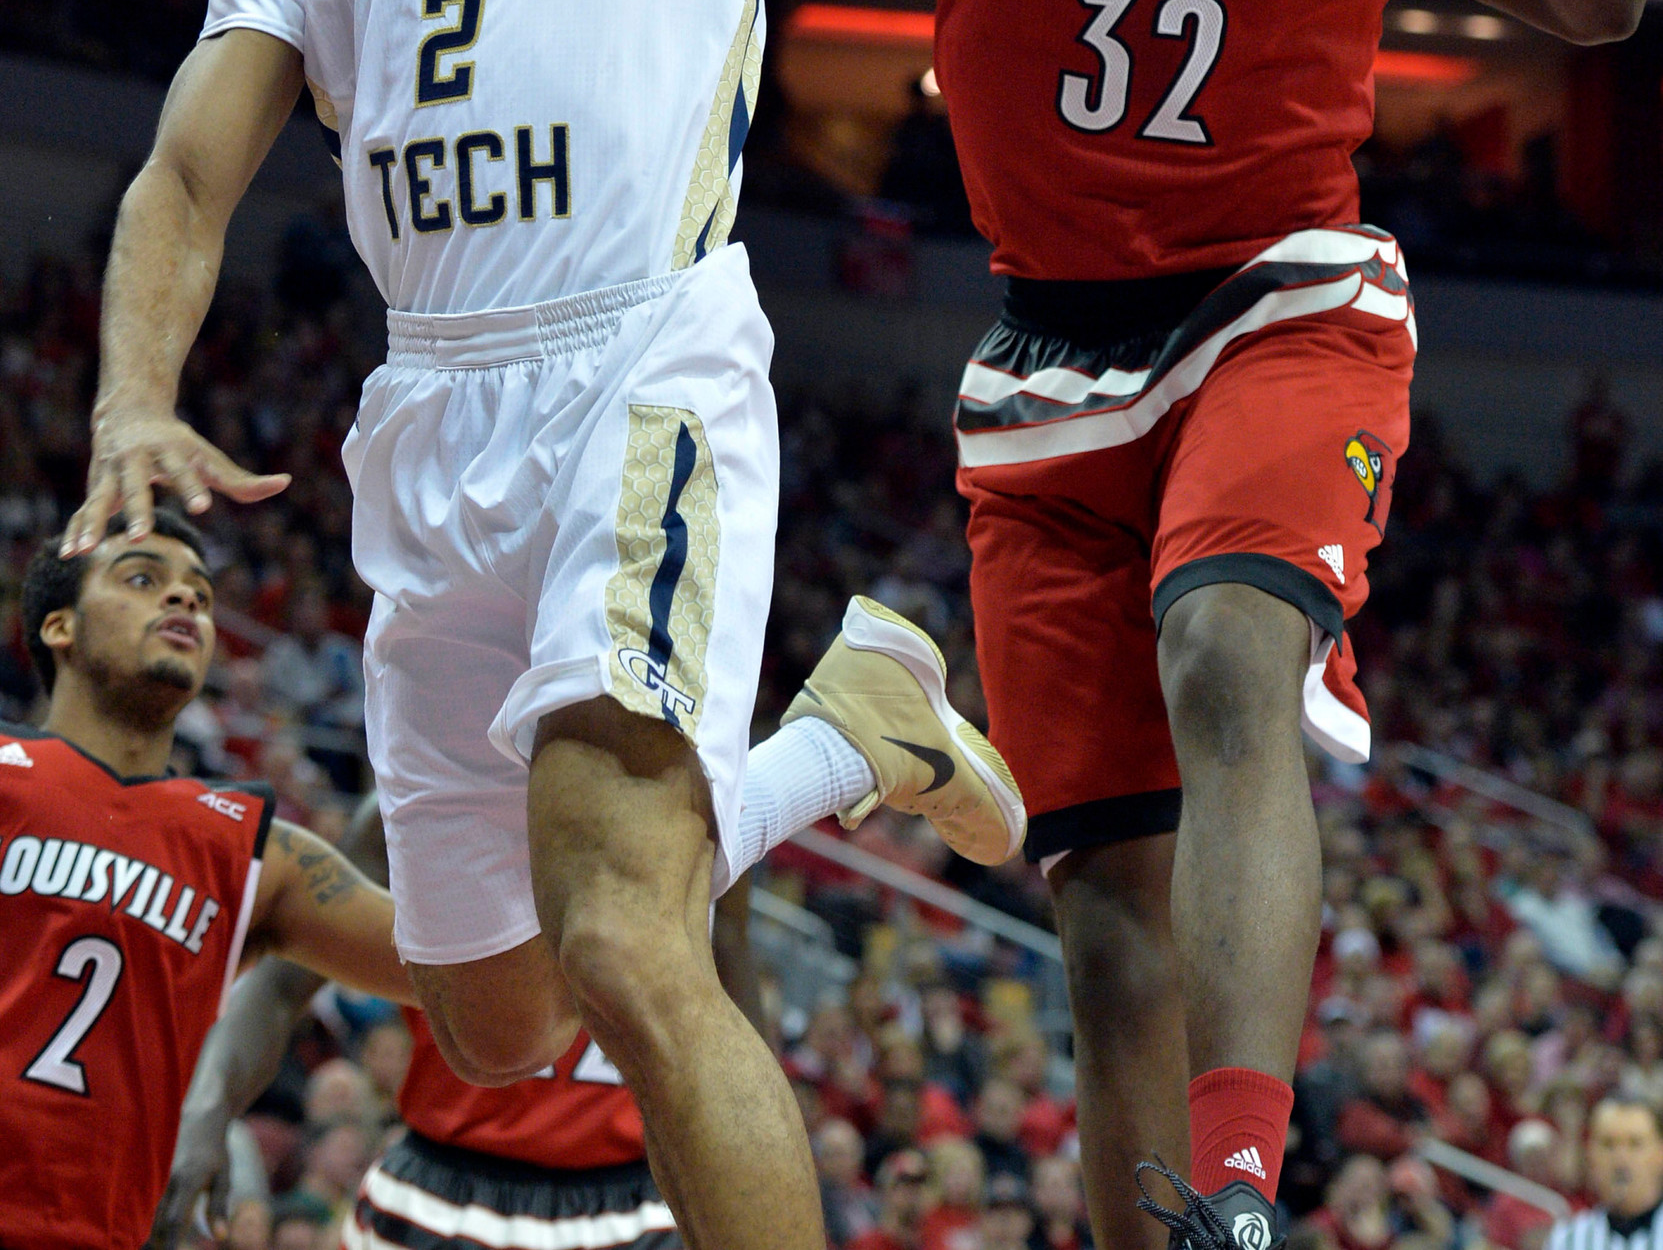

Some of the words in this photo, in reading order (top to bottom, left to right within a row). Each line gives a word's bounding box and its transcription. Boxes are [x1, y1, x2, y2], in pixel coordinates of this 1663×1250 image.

[369, 121, 573, 242] TECH
[196, 792, 248, 822] ACC
[0, 835, 220, 955] OUISVILLE
[21, 933, 125, 1097] 2
[1224, 1157, 1267, 1180] adidas
